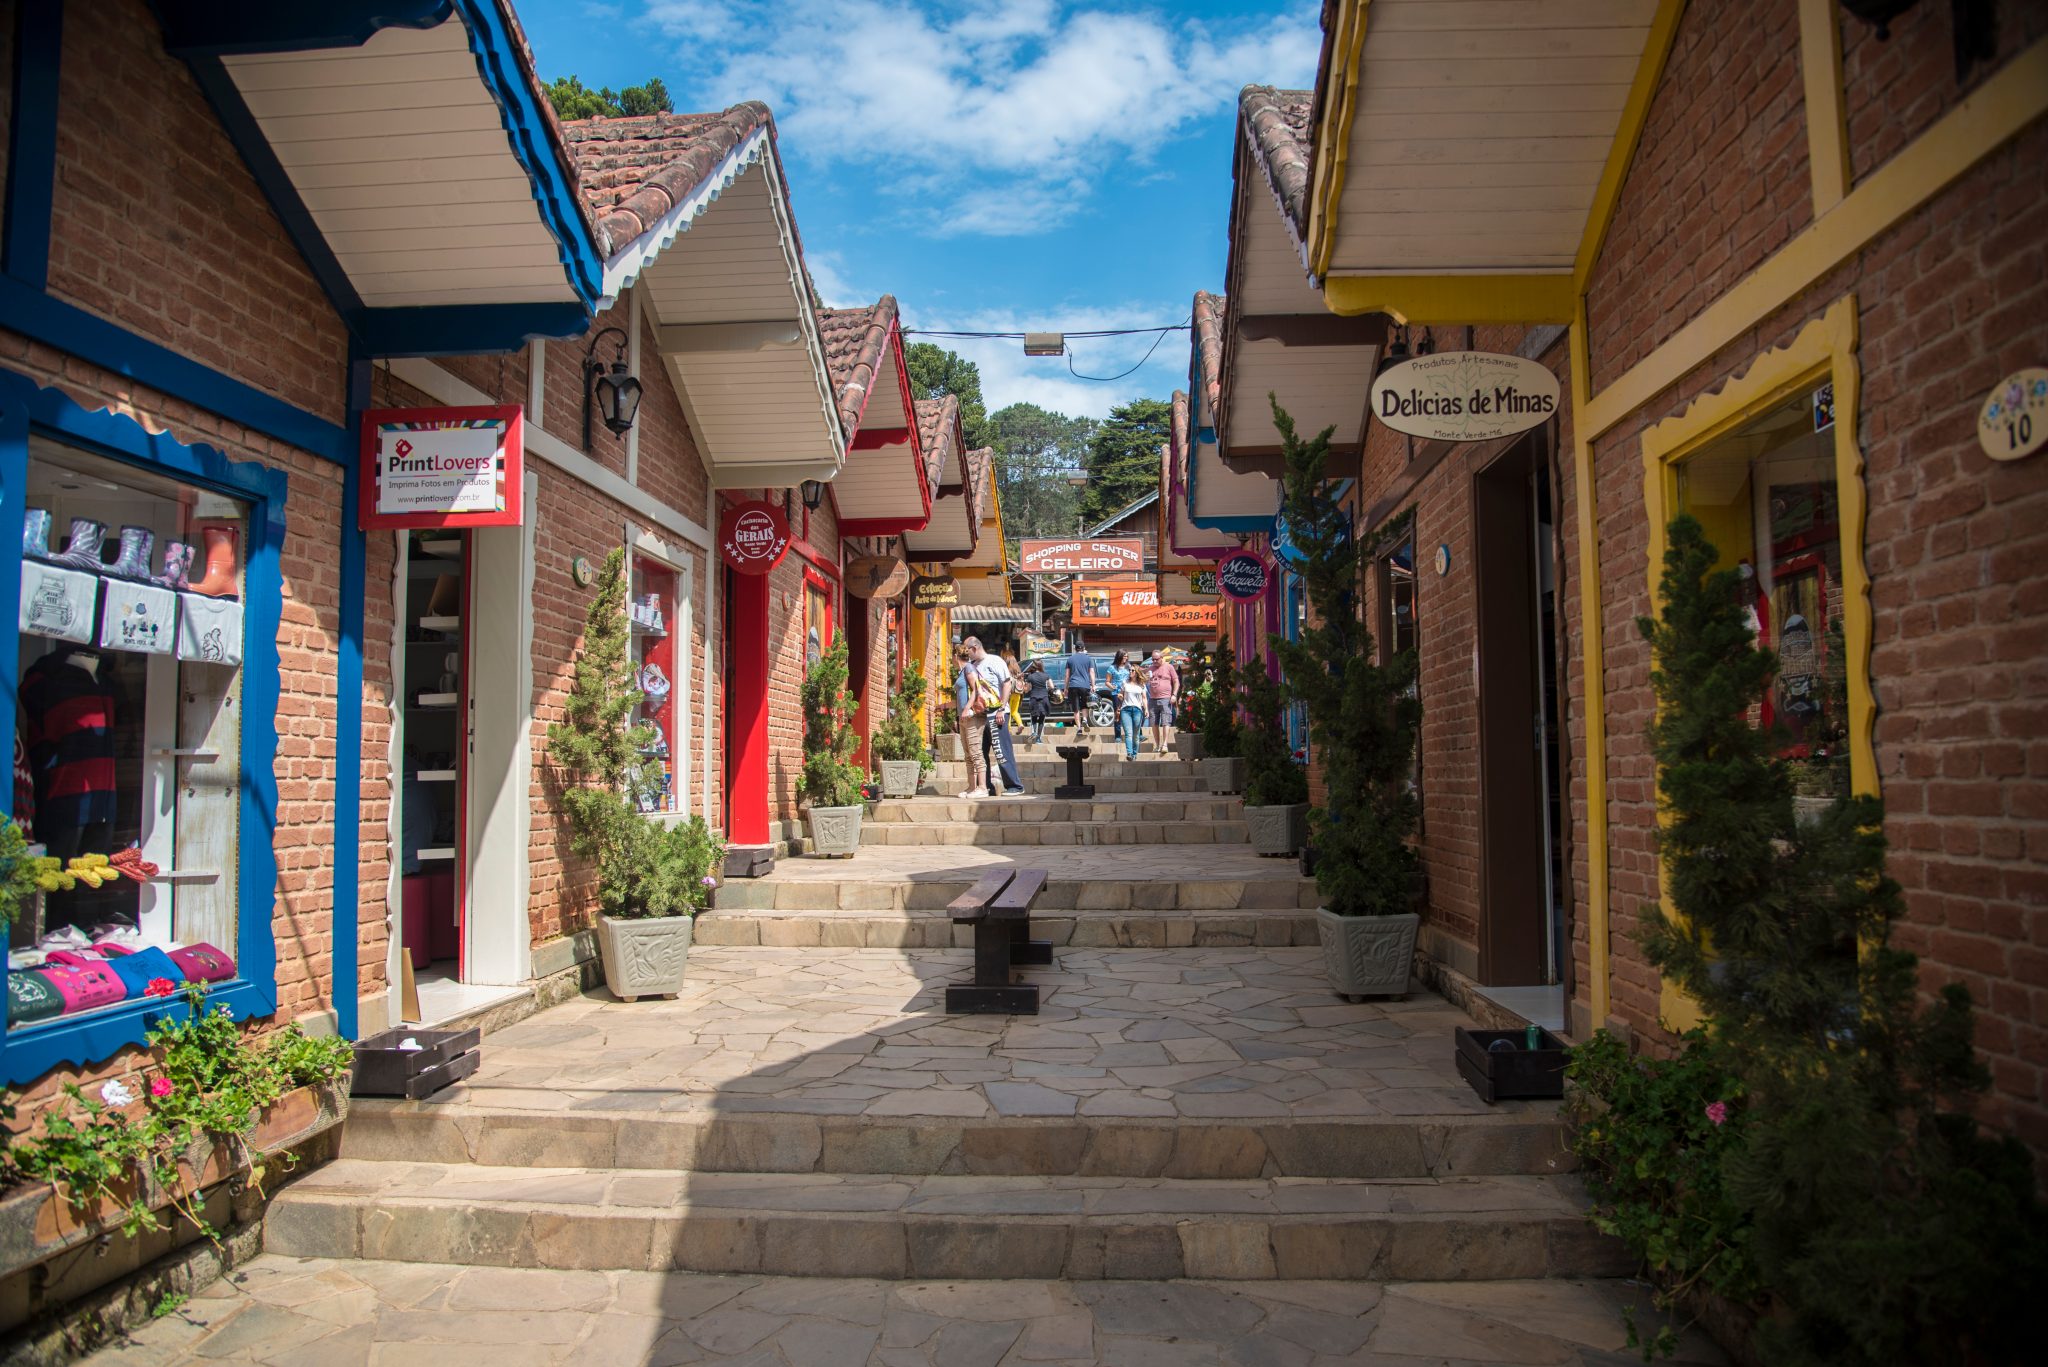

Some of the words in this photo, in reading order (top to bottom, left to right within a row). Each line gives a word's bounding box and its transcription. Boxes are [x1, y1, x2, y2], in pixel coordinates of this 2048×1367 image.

[1412, 358, 1457, 371] Produtos
[1461, 354, 1520, 370] Artesanais
[1381, 389, 1462, 417] Delícias
[1468, 389, 1492, 415] de
[1495, 386, 1553, 413] Minas
[1434, 429, 1460, 439] Monte
[1463, 431, 1487, 439] Verde
[2007, 413, 2033, 451] 10
[389, 454, 490, 473] PrintLovers
[388, 480, 419, 491] Imprima
[421, 480, 441, 488] Fotos
[456, 478, 490, 487] Produtos
[397, 493, 480, 504] www.printlovers.com.br
[735, 526, 774, 543] GERAIS
[1025, 543, 1082, 564] SHOPPING
[1091, 543, 1138, 562] CENTER
[1040, 557, 1123, 570] CELEIRO
[1221, 559, 1262, 575] Minas
[1217, 572, 1268, 588] Jaquetas
[1121, 592, 1159, 606] SUPER
